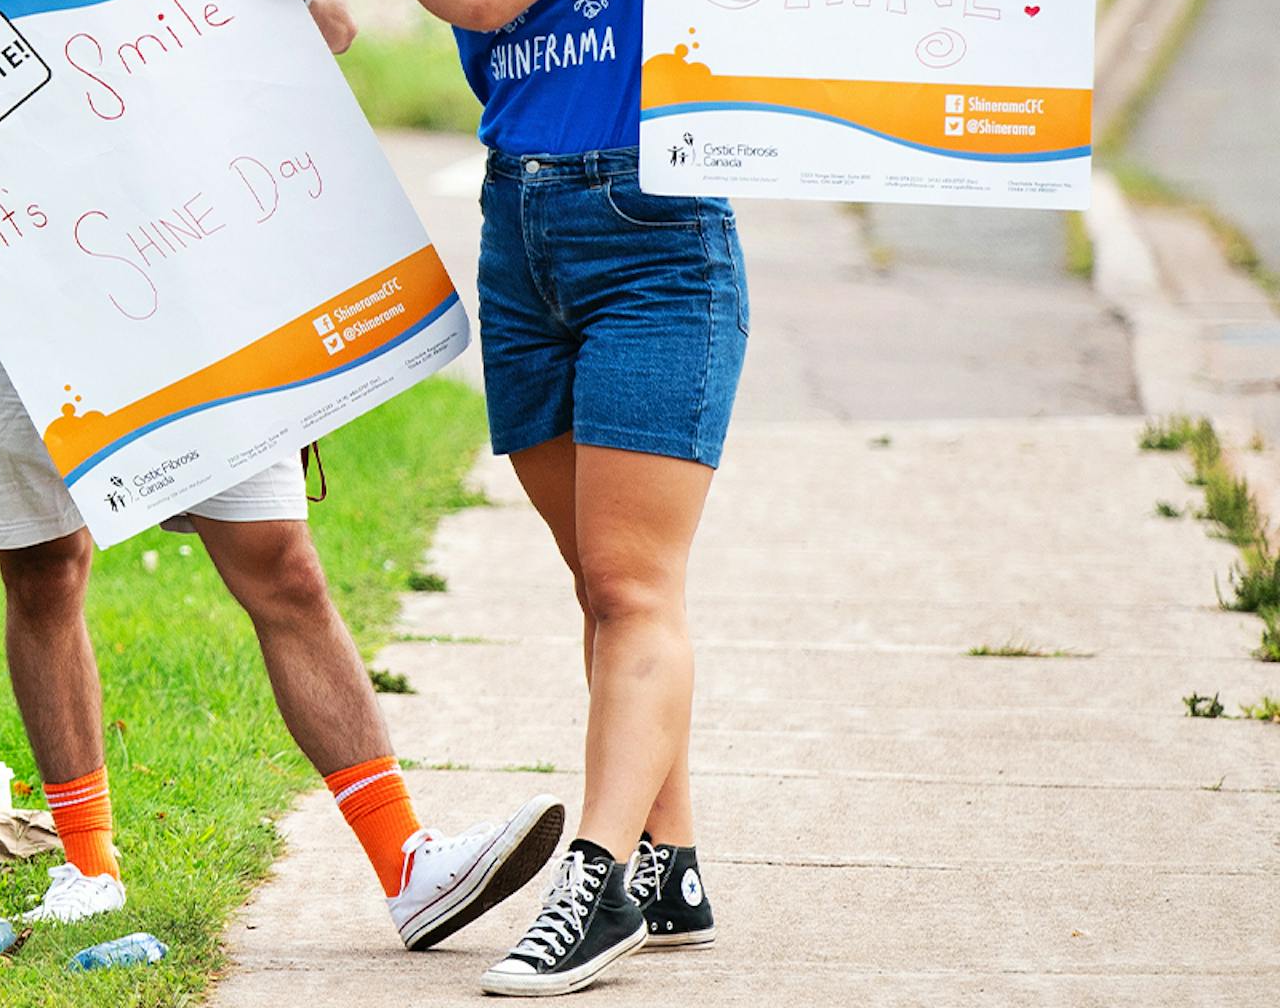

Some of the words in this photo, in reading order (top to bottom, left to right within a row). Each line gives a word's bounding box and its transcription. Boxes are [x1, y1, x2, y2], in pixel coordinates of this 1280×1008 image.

[490, 26, 616, 82] SHINERAMA
[967, 96, 1045, 116] ShineramaCFC
[965, 119, 1036, 138] @Shinerama
[703, 156, 742, 168] Canada
[737, 144, 779, 158] Fibrosis
[74, 191, 227, 321] SHINE
[229, 152, 323, 224] Day
[333, 276, 402, 325] ShineramaCFC
[342, 302, 406, 344] @Shinerama
[138, 476, 175, 498] Canada
